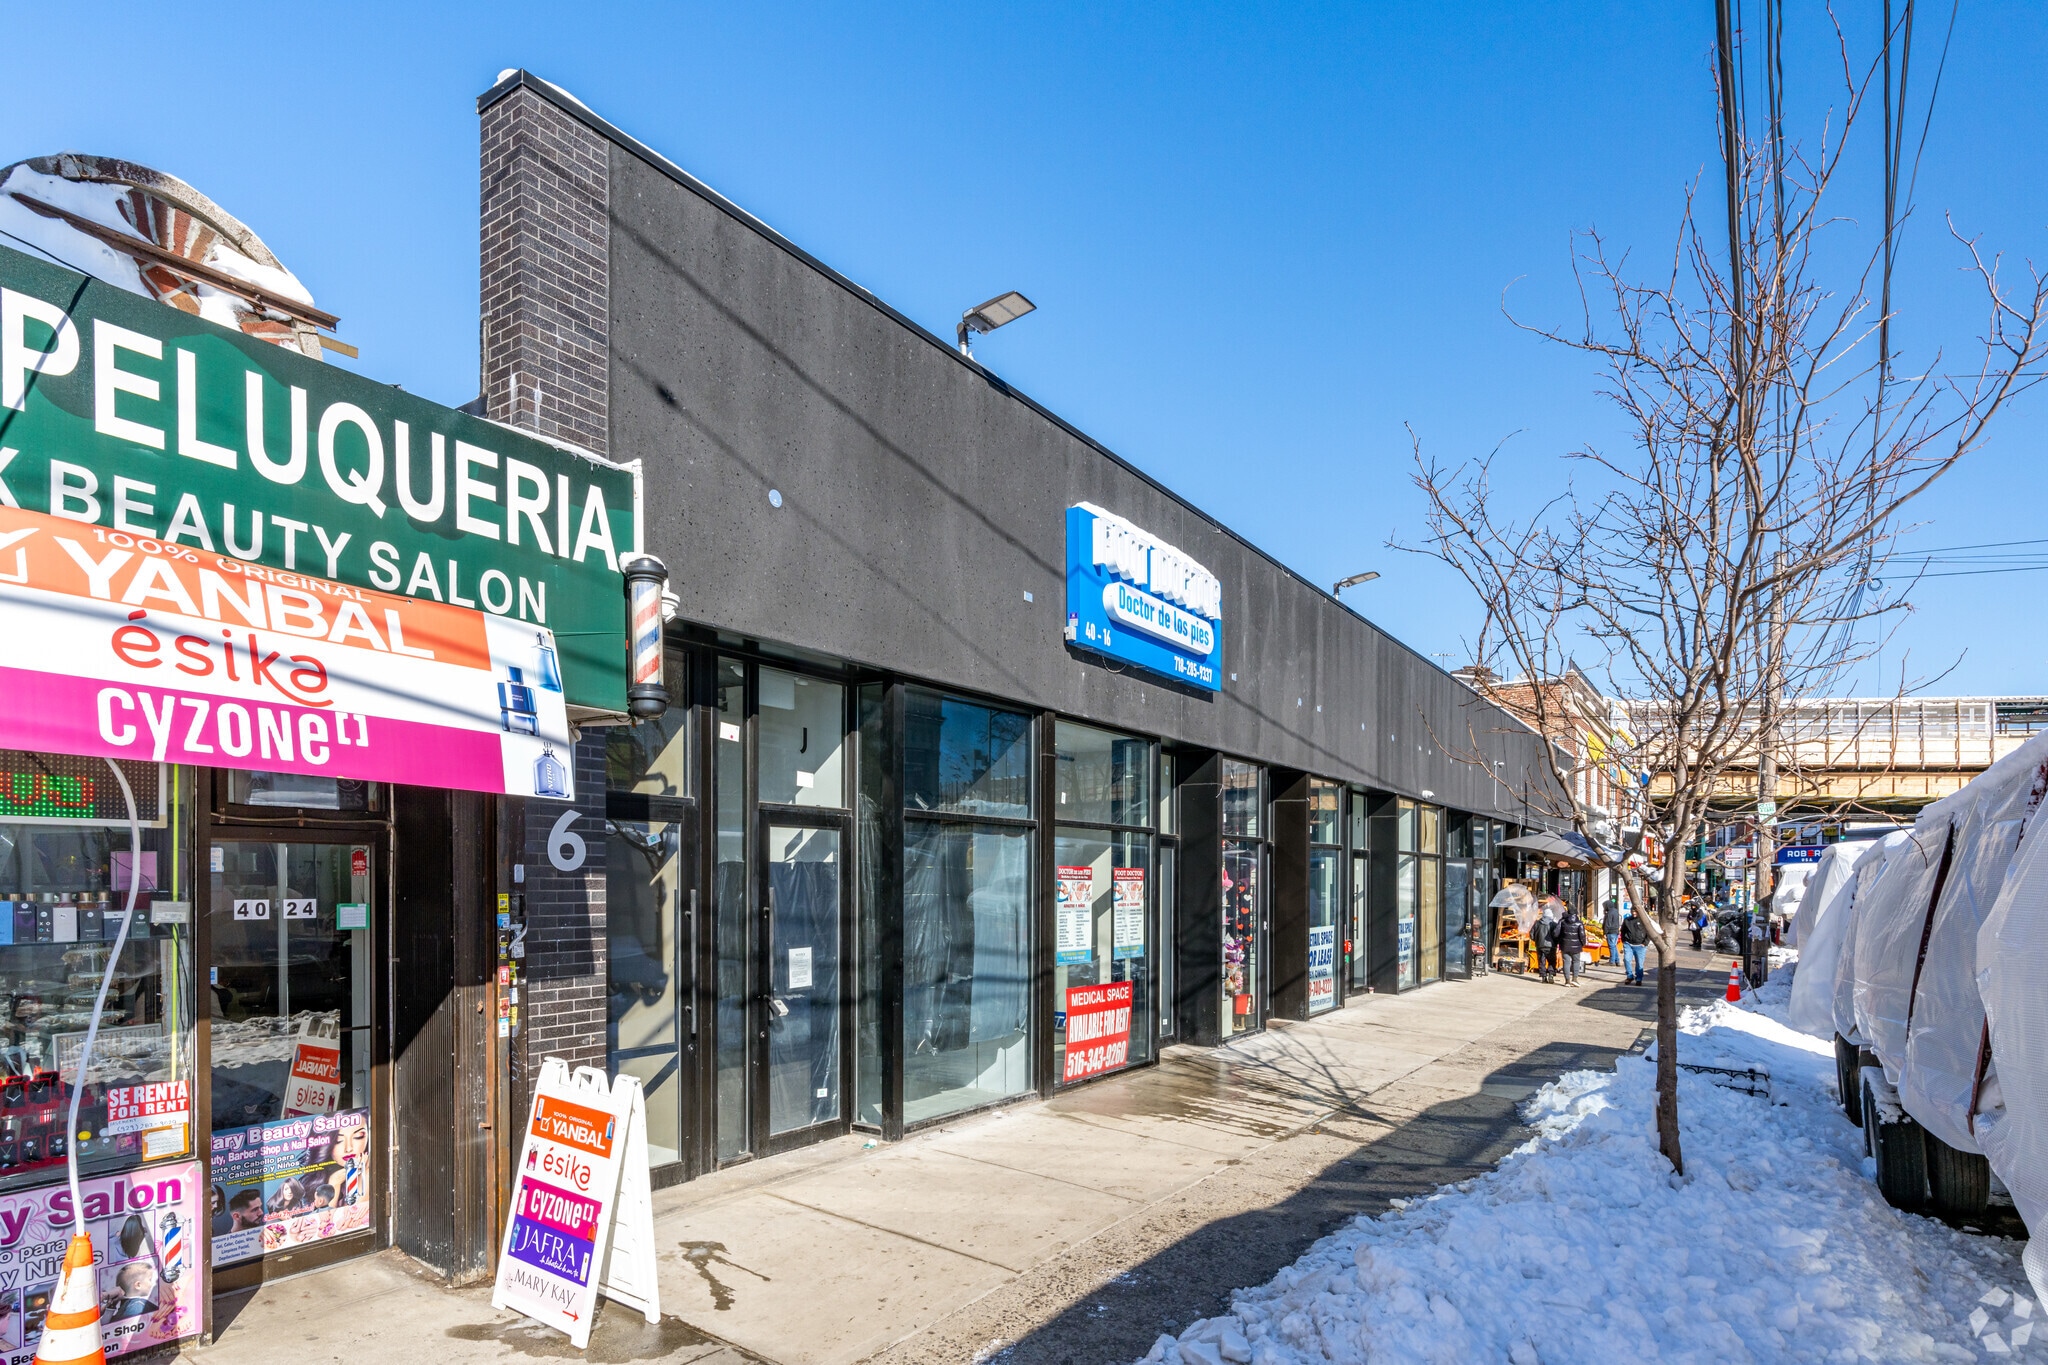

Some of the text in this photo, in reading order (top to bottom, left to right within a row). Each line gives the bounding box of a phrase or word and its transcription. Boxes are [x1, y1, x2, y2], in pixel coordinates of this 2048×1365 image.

[1, 287, 620, 574] PELUQUERIA
[50, 458, 352, 579] BEAUTY
[368, 541, 546, 624] SALON
[93, 528, 371, 604] 100% ORIGINAL
[53, 536, 435, 660] YANBAL
[1118, 585, 1210, 647] Doctor de los pies
[111, 609, 334, 708] ésika
[547, 809, 587, 872] 6
[237, 901, 314, 917] 40 24
[1317, 948, 1333, 966] LEASE
[1071, 987, 1129, 1007] MEDICAL SPACE
[1068, 1006, 1130, 1044] AVAILABLE FOR RENT
[1067, 1040, 1126, 1077] 516-343-9260
[109, 1080, 188, 1108] SE RENTA
[109, 1099, 187, 1120] FOR RENT
[247, 1120, 312, 1144] Beauty
[313, 1113, 361, 1132] Salon
[552, 1118, 606, 1150] YANBAL
[228, 1148, 259, 1162] Barber
[260, 1144, 281, 1157] Shop
[283, 1142, 290, 1152] &
[291, 1138, 307, 1150] Nail
[308, 1135, 331, 1147] Salon
[230, 1163, 242, 1172] de
[243, 1156, 275, 1169] Cabello
[277, 1154, 295, 1164] para
[228, 1167, 268, 1181] Caballero
[277, 1159, 300, 1170] Niños
[543, 1146, 591, 1191] ésika
[49, 1178, 182, 1227] Salon
[20, 1239, 68, 1263] para
[517, 1225, 575, 1267] JAFRA
[514, 1268, 576, 1309] MARY KAY
[114, 1321, 145, 1338] Shop
